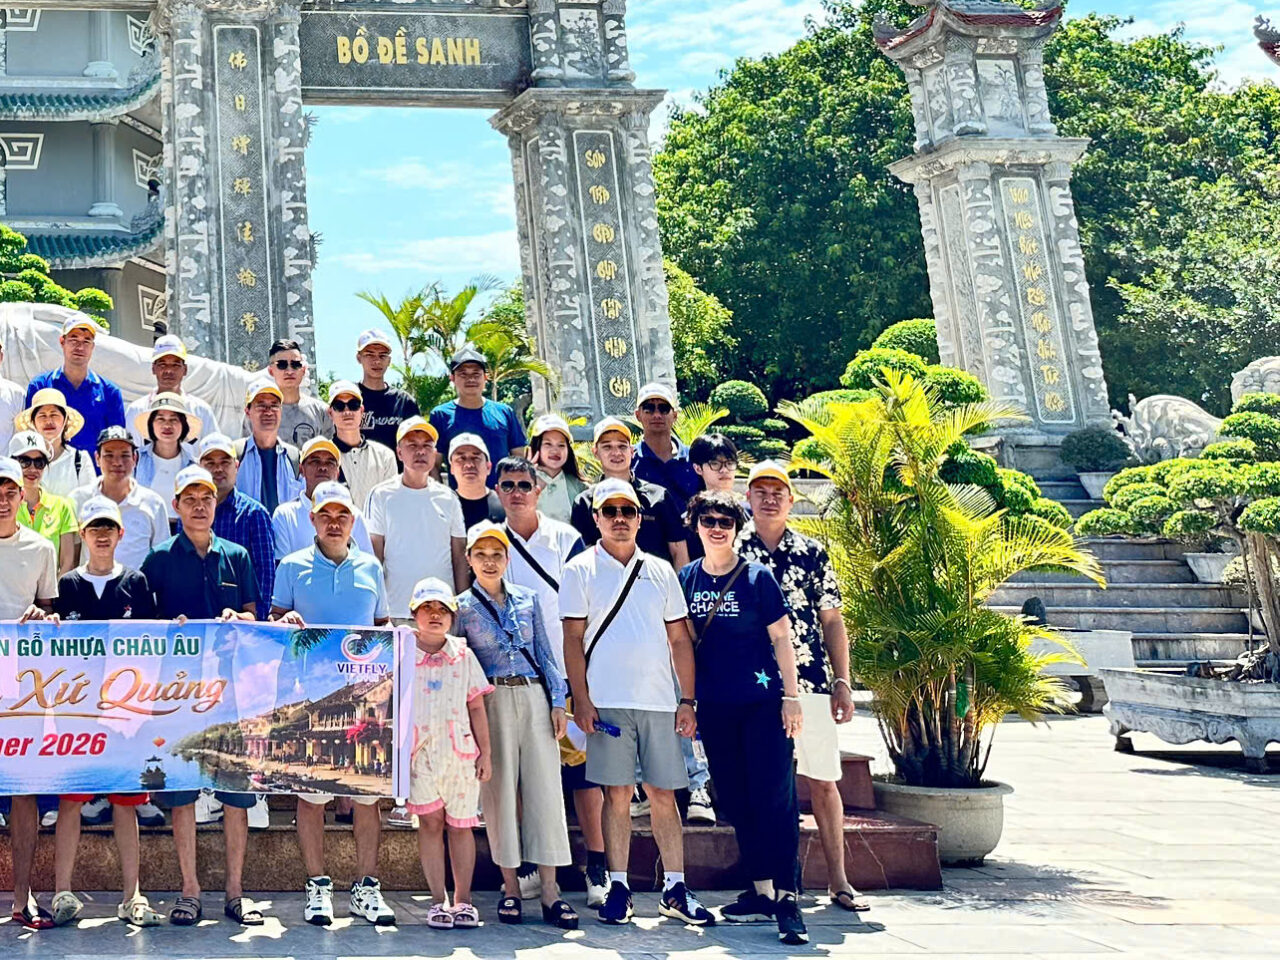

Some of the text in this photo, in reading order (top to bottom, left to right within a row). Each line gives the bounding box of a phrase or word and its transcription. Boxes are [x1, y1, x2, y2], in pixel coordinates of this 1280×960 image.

[337, 26, 481, 65] BỒ ĐỀ SANH
[690, 601, 740, 613] CHANCE
[17, 633, 42, 656] GỖ
[51, 637, 106, 659] NHỰA
[113, 635, 166, 655] CHÂU
[173, 635, 199, 655] ÂU
[337, 663, 386, 674] VIETFLY
[6, 668, 91, 709] Xứ
[97, 668, 228, 716] Quảng
[38, 733, 107, 756] 2026
